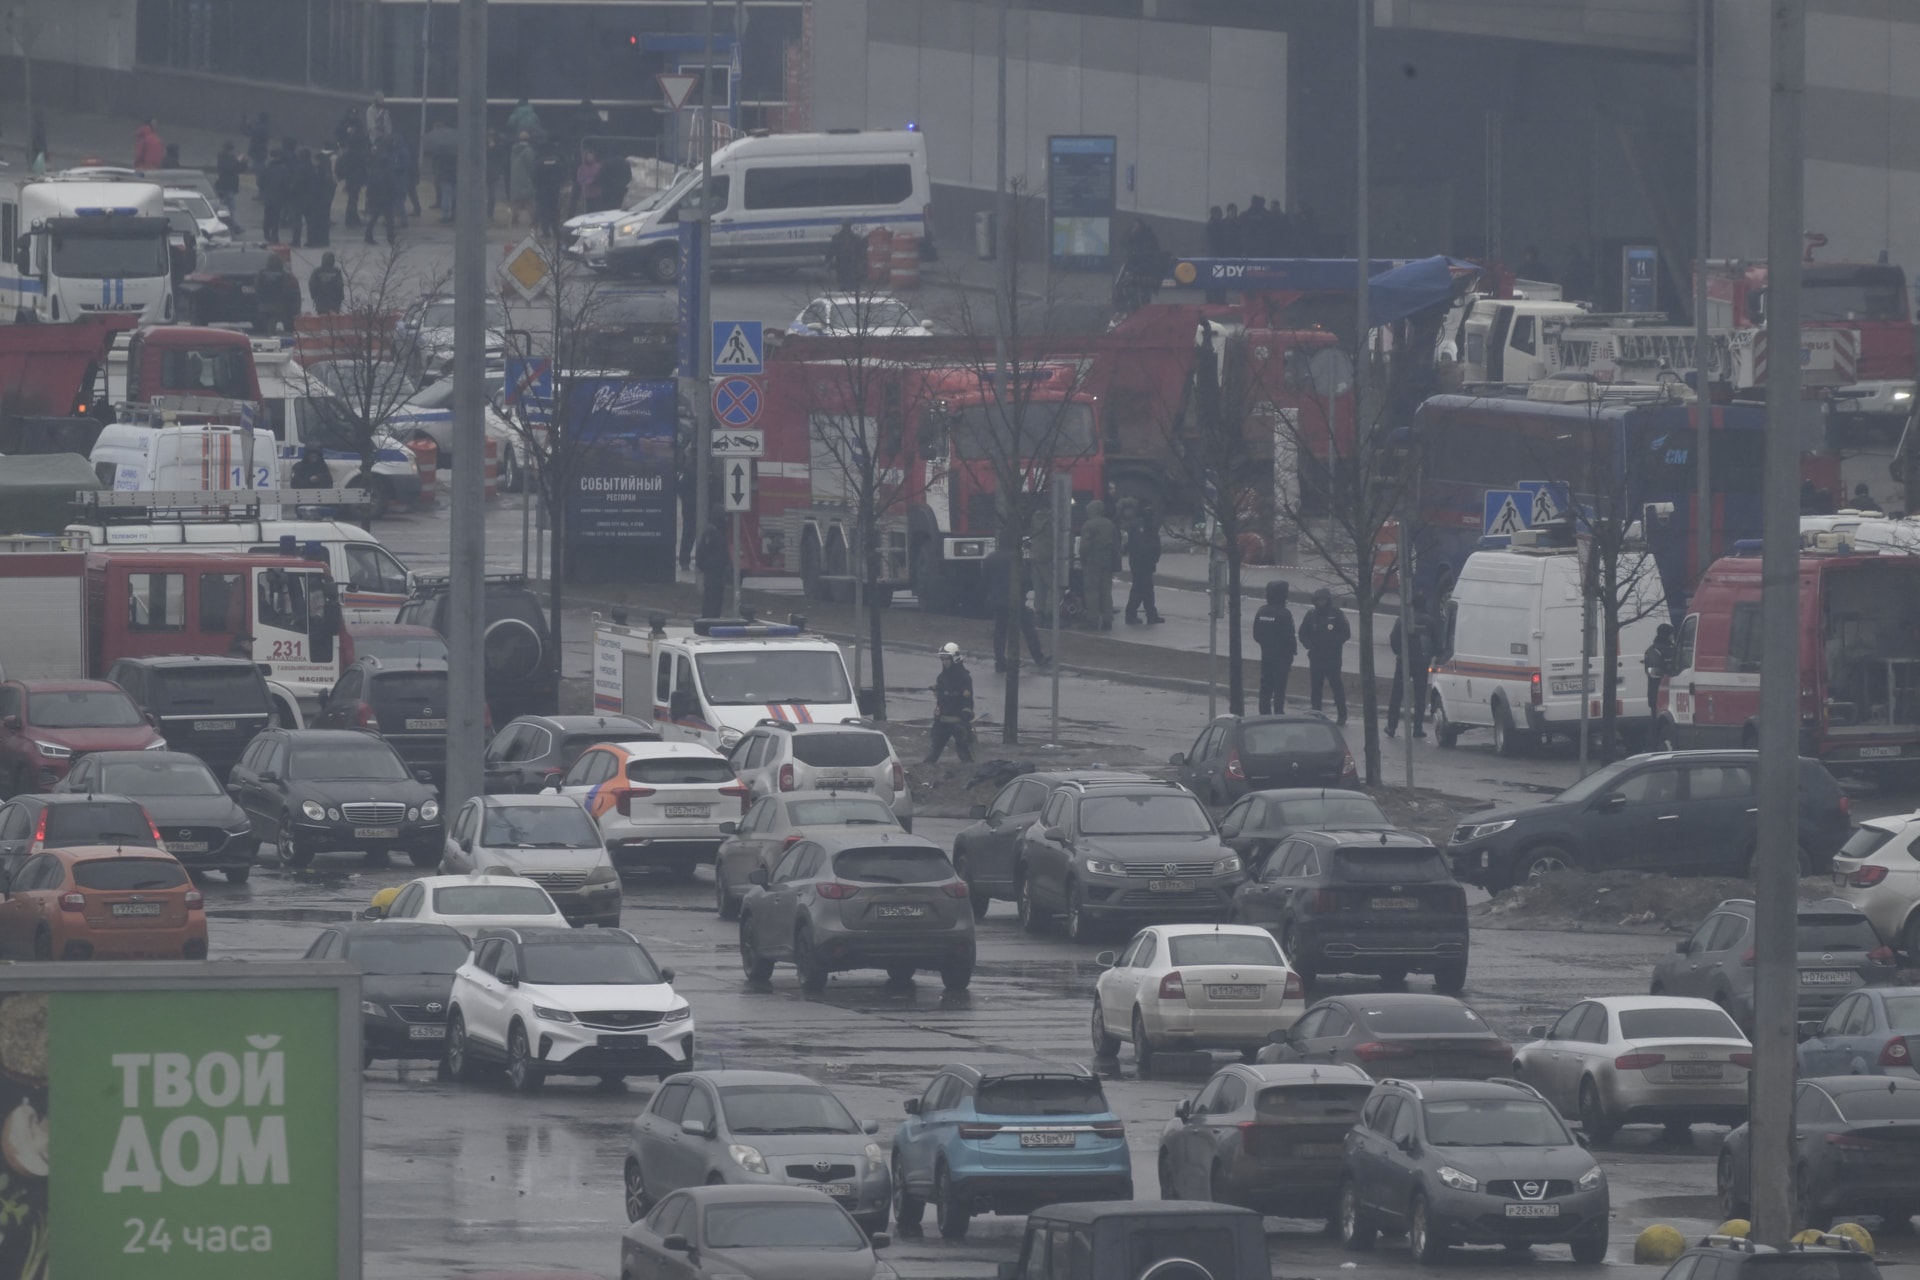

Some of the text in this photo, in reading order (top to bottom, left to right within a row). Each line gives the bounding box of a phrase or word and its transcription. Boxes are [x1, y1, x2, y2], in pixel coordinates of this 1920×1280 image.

[231, 467, 271, 489] 12
[580, 476, 663, 491] СОБЫТИЙНЫЙ
[273, 640, 302, 657] 231
[112, 1034, 285, 1108] ТВОЙ
[103, 1115, 290, 1193] ДОМ
[123, 1217, 272, 1254] 24 часа
